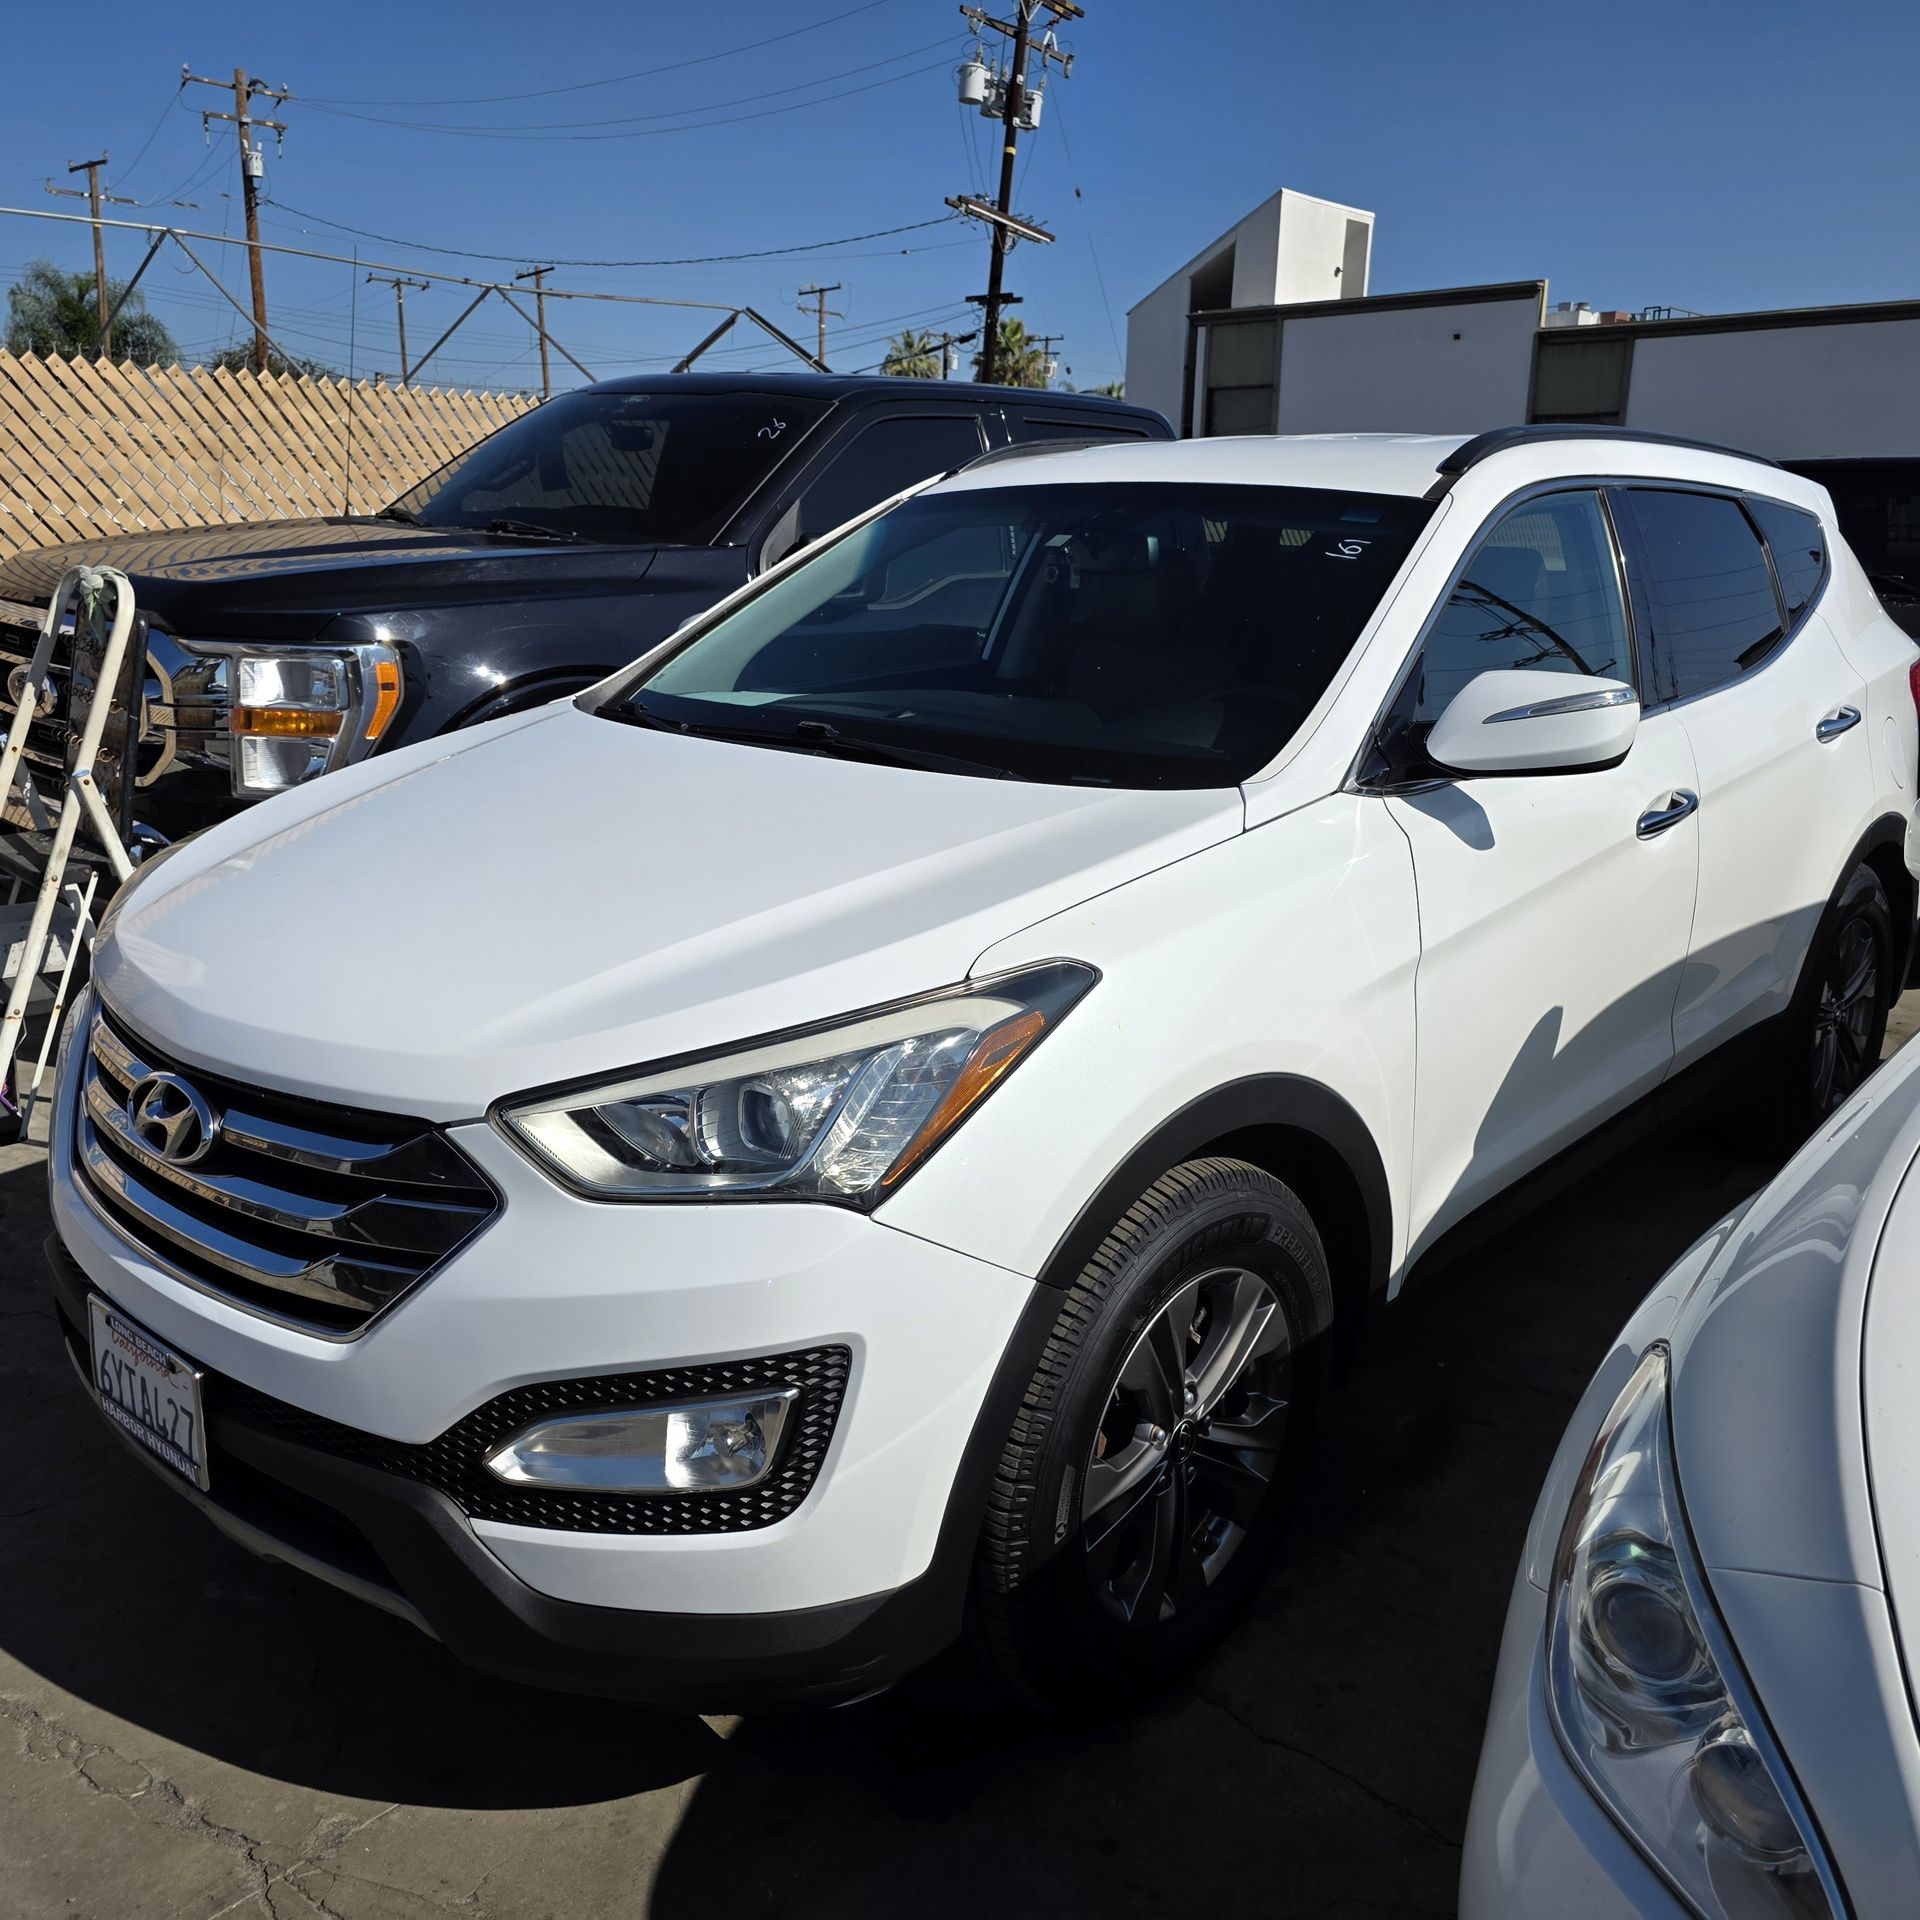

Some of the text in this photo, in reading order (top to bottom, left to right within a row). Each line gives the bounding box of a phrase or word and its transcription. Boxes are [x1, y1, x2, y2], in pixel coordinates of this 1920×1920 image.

[757, 417, 787, 439] 26
[1325, 539, 1372, 560] 161
[110, 1316, 168, 1367] LONG BEACH
[100, 1348, 195, 1460] 6YTA427
[101, 1396, 197, 1482] HARBOR HYUNDAI
